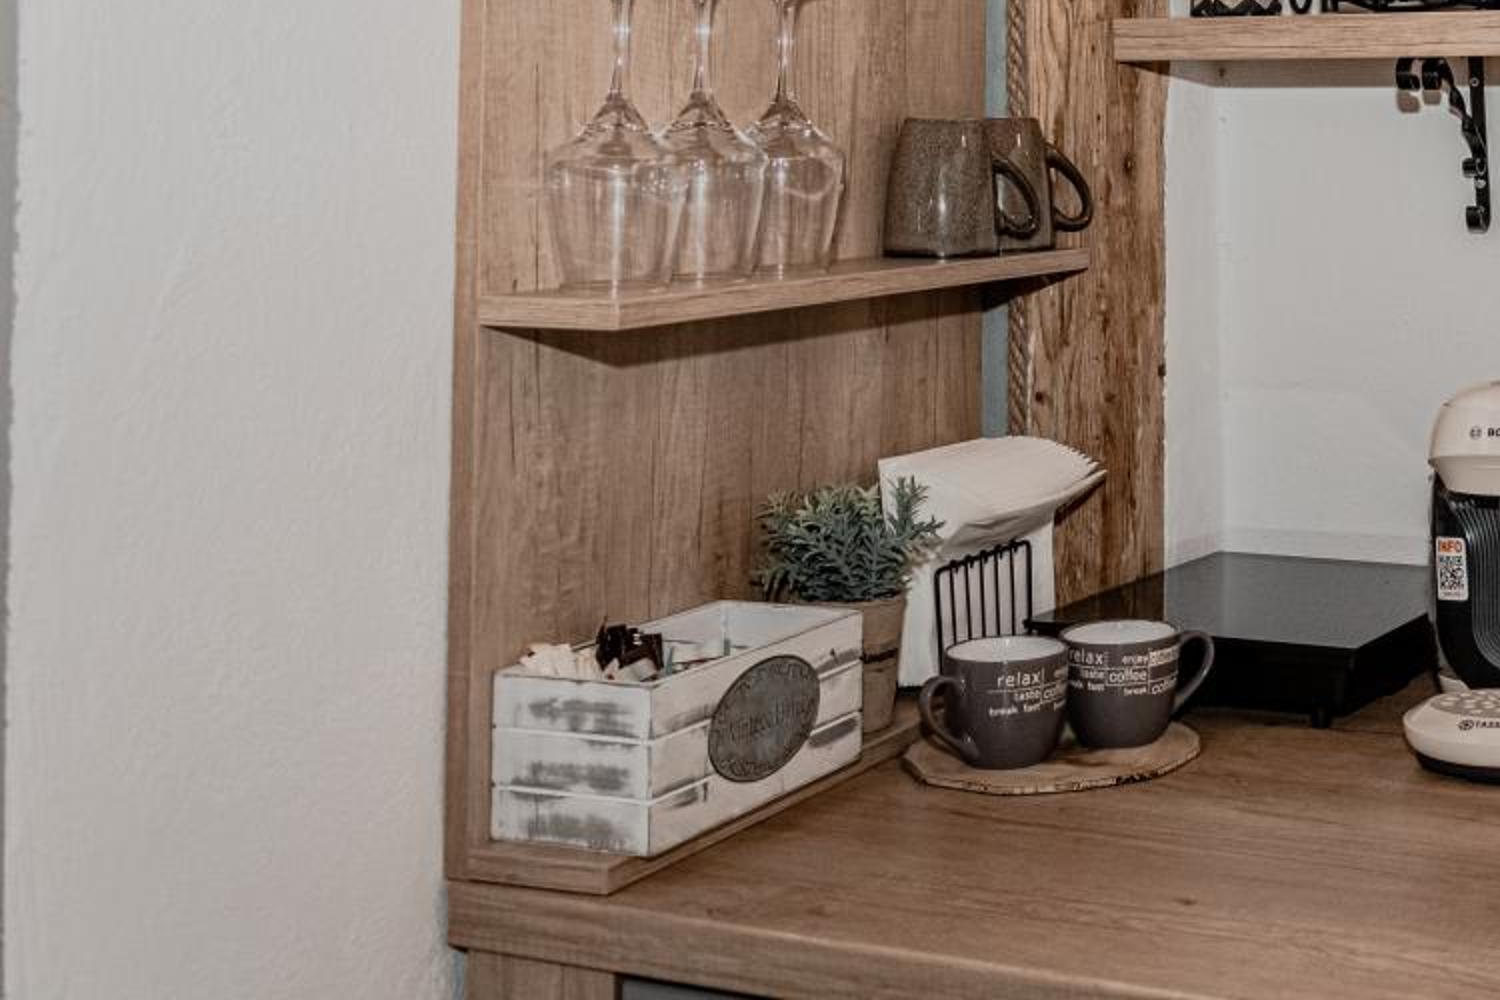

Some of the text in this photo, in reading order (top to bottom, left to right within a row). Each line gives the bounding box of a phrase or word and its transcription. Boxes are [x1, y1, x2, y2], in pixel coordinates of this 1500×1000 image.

[1069, 647, 1103, 664] relax
[997, 671, 1040, 688] relax
[1109, 667, 1147, 683] coffee
